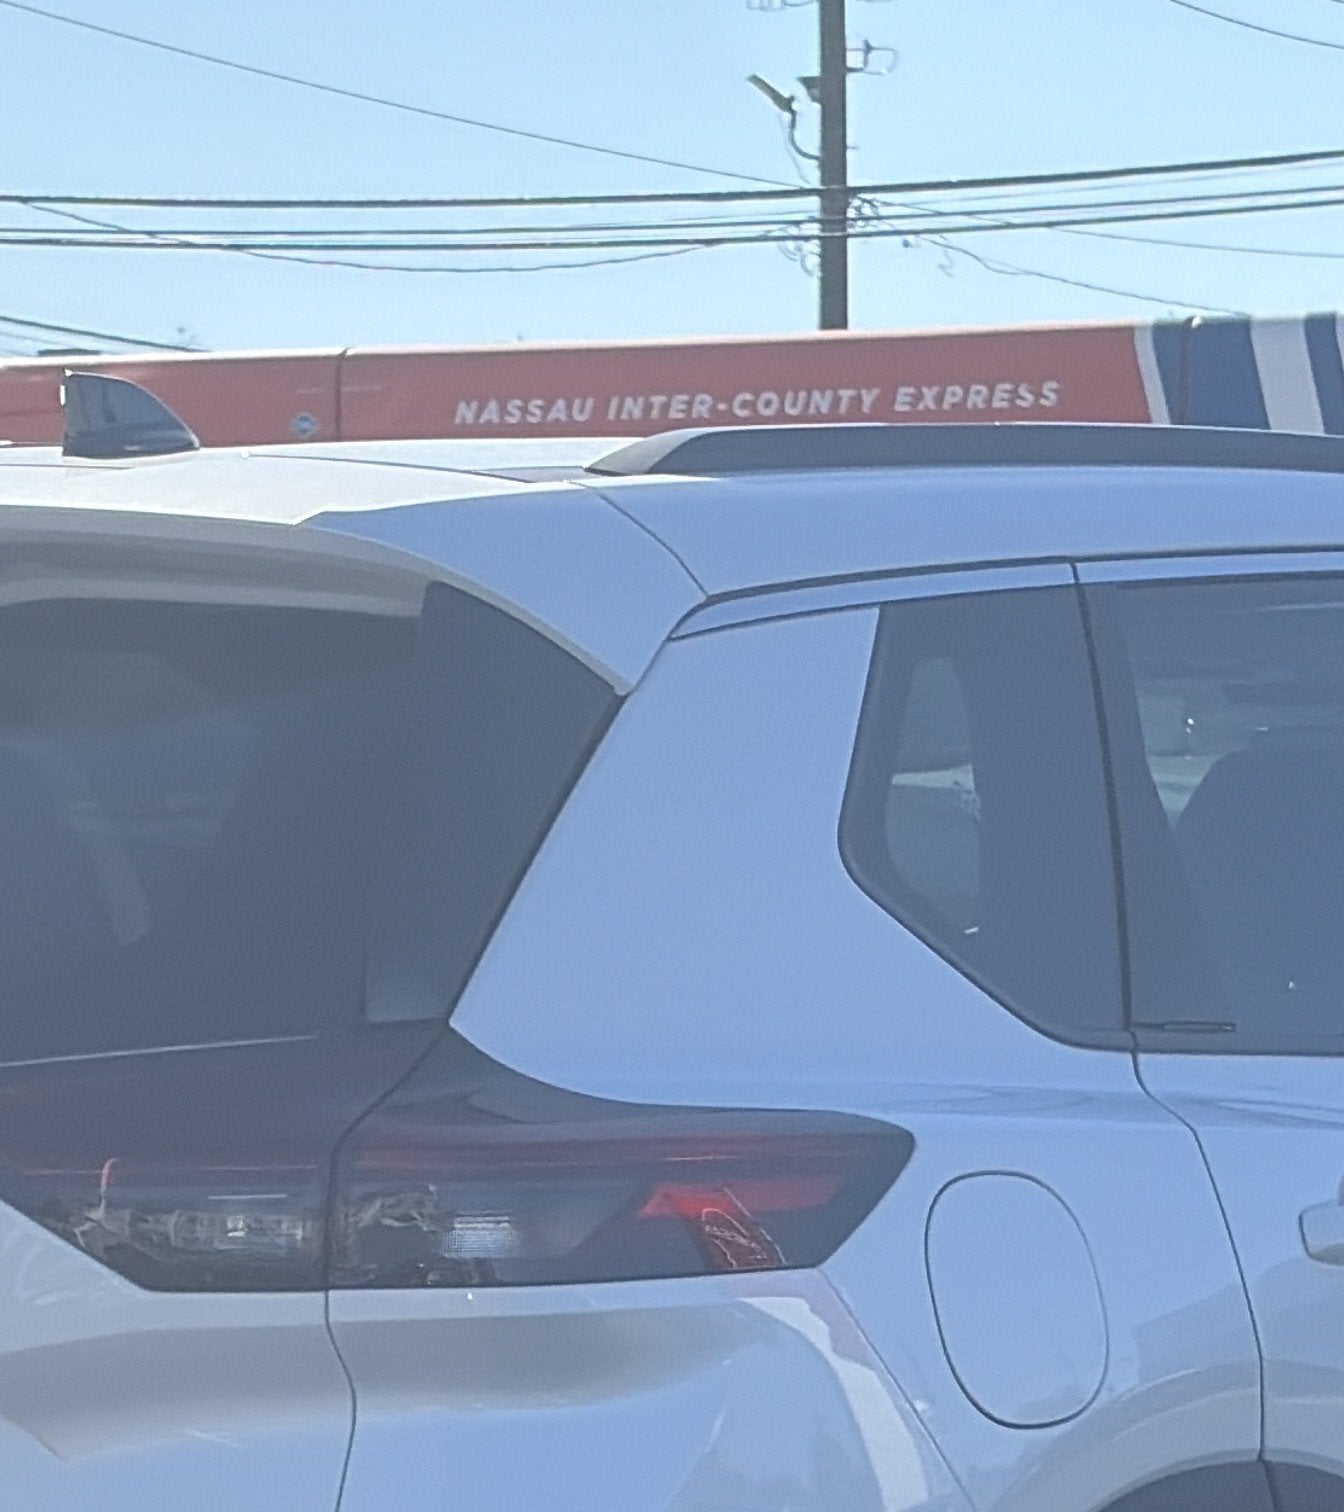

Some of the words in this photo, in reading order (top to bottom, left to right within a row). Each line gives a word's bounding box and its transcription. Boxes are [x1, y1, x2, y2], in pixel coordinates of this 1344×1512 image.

[455, 397, 595, 425] NASSAU
[606, 387, 881, 421] INTER-COUNTY
[894, 380, 1061, 412] EXPRESS
